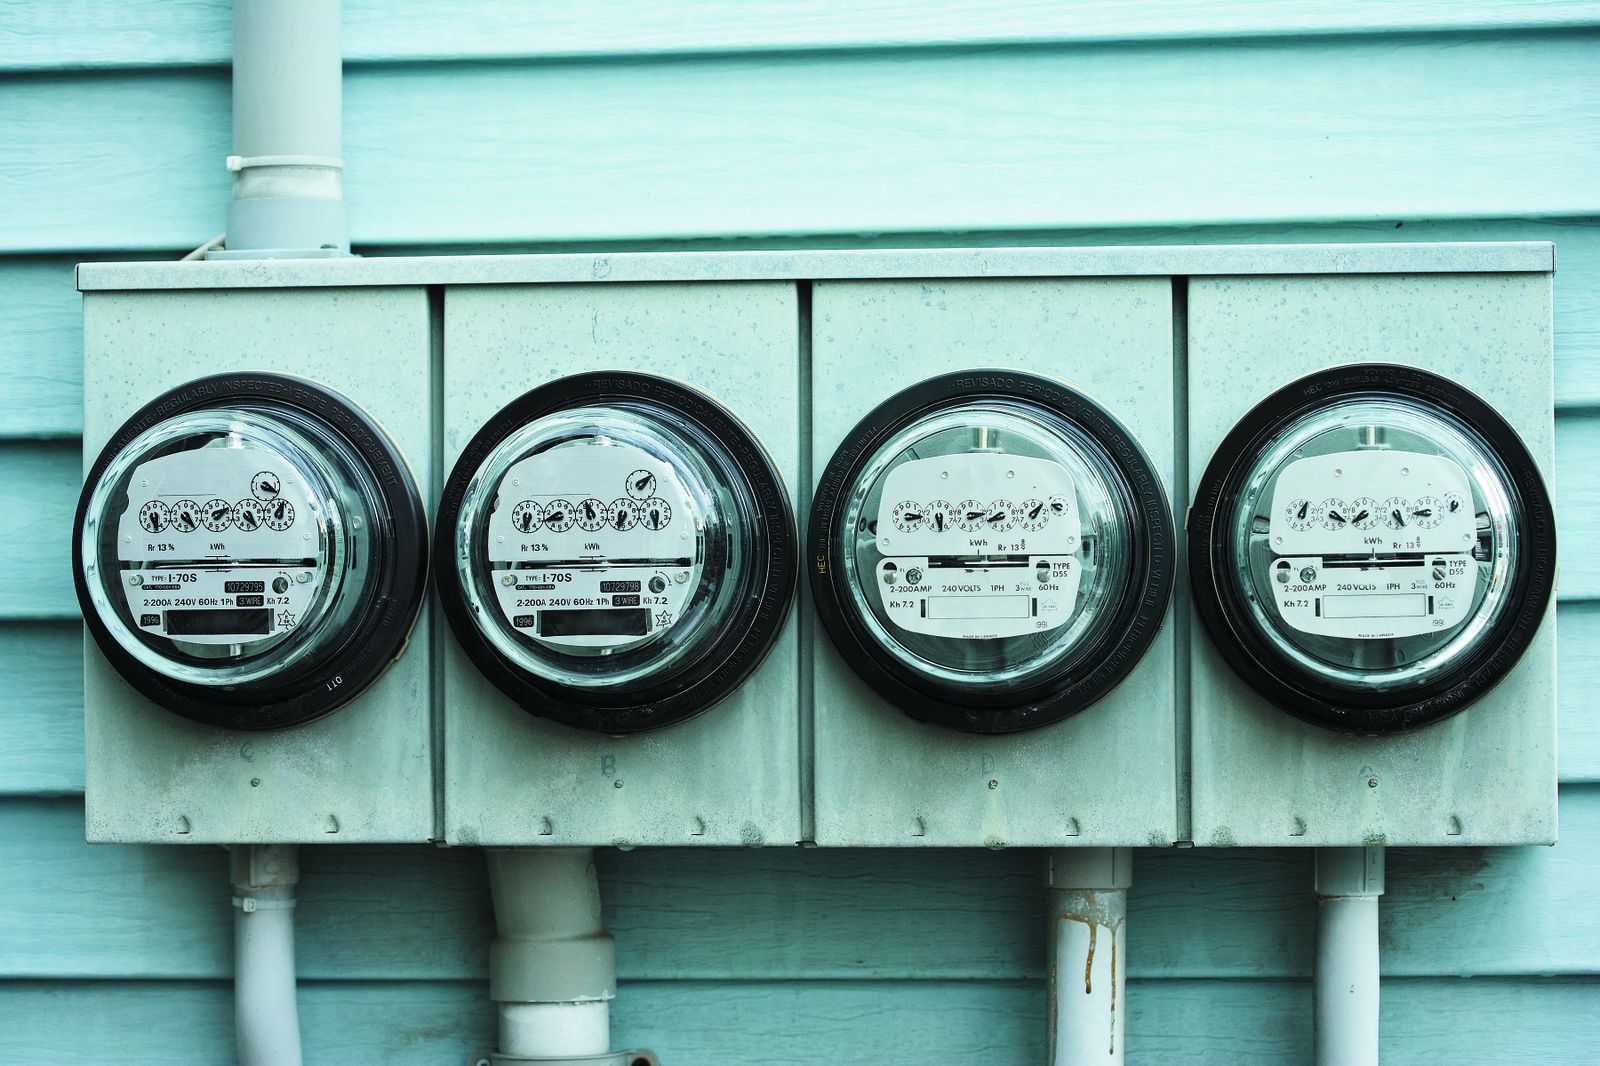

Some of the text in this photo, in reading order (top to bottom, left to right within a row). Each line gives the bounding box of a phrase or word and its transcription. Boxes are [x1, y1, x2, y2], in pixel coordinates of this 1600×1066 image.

[227, 582, 263, 592] 10729795
[602, 581, 639, 592] 10729798
[143, 616, 159, 624] 1996
[516, 617, 532, 626] 1996
[326, 676, 344, 692] 110
